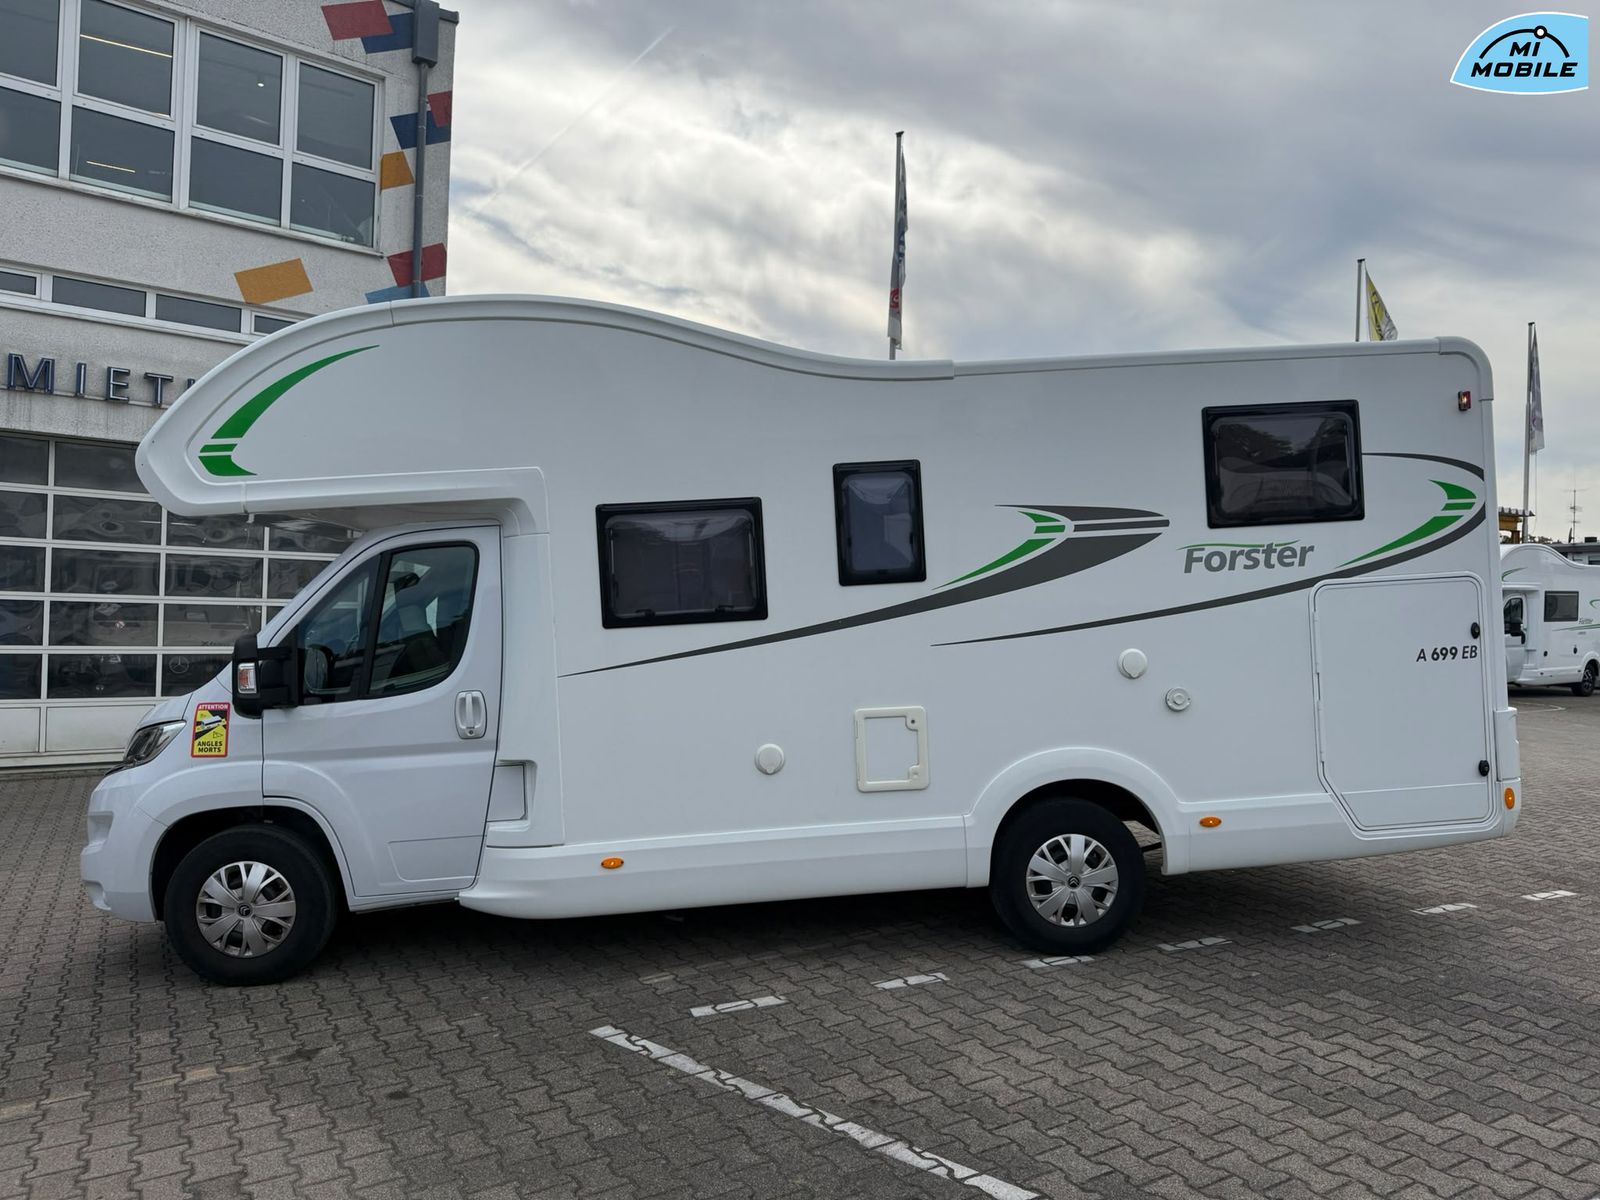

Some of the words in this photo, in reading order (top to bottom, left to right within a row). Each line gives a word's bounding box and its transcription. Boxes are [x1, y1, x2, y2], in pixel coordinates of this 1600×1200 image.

[7, 353, 196, 408] MIET
[1184, 542, 1315, 574] Forster
[1416, 648, 1427, 662] A
[1431, 646, 1458, 661] 699
[1461, 645, 1478, 659] EB
